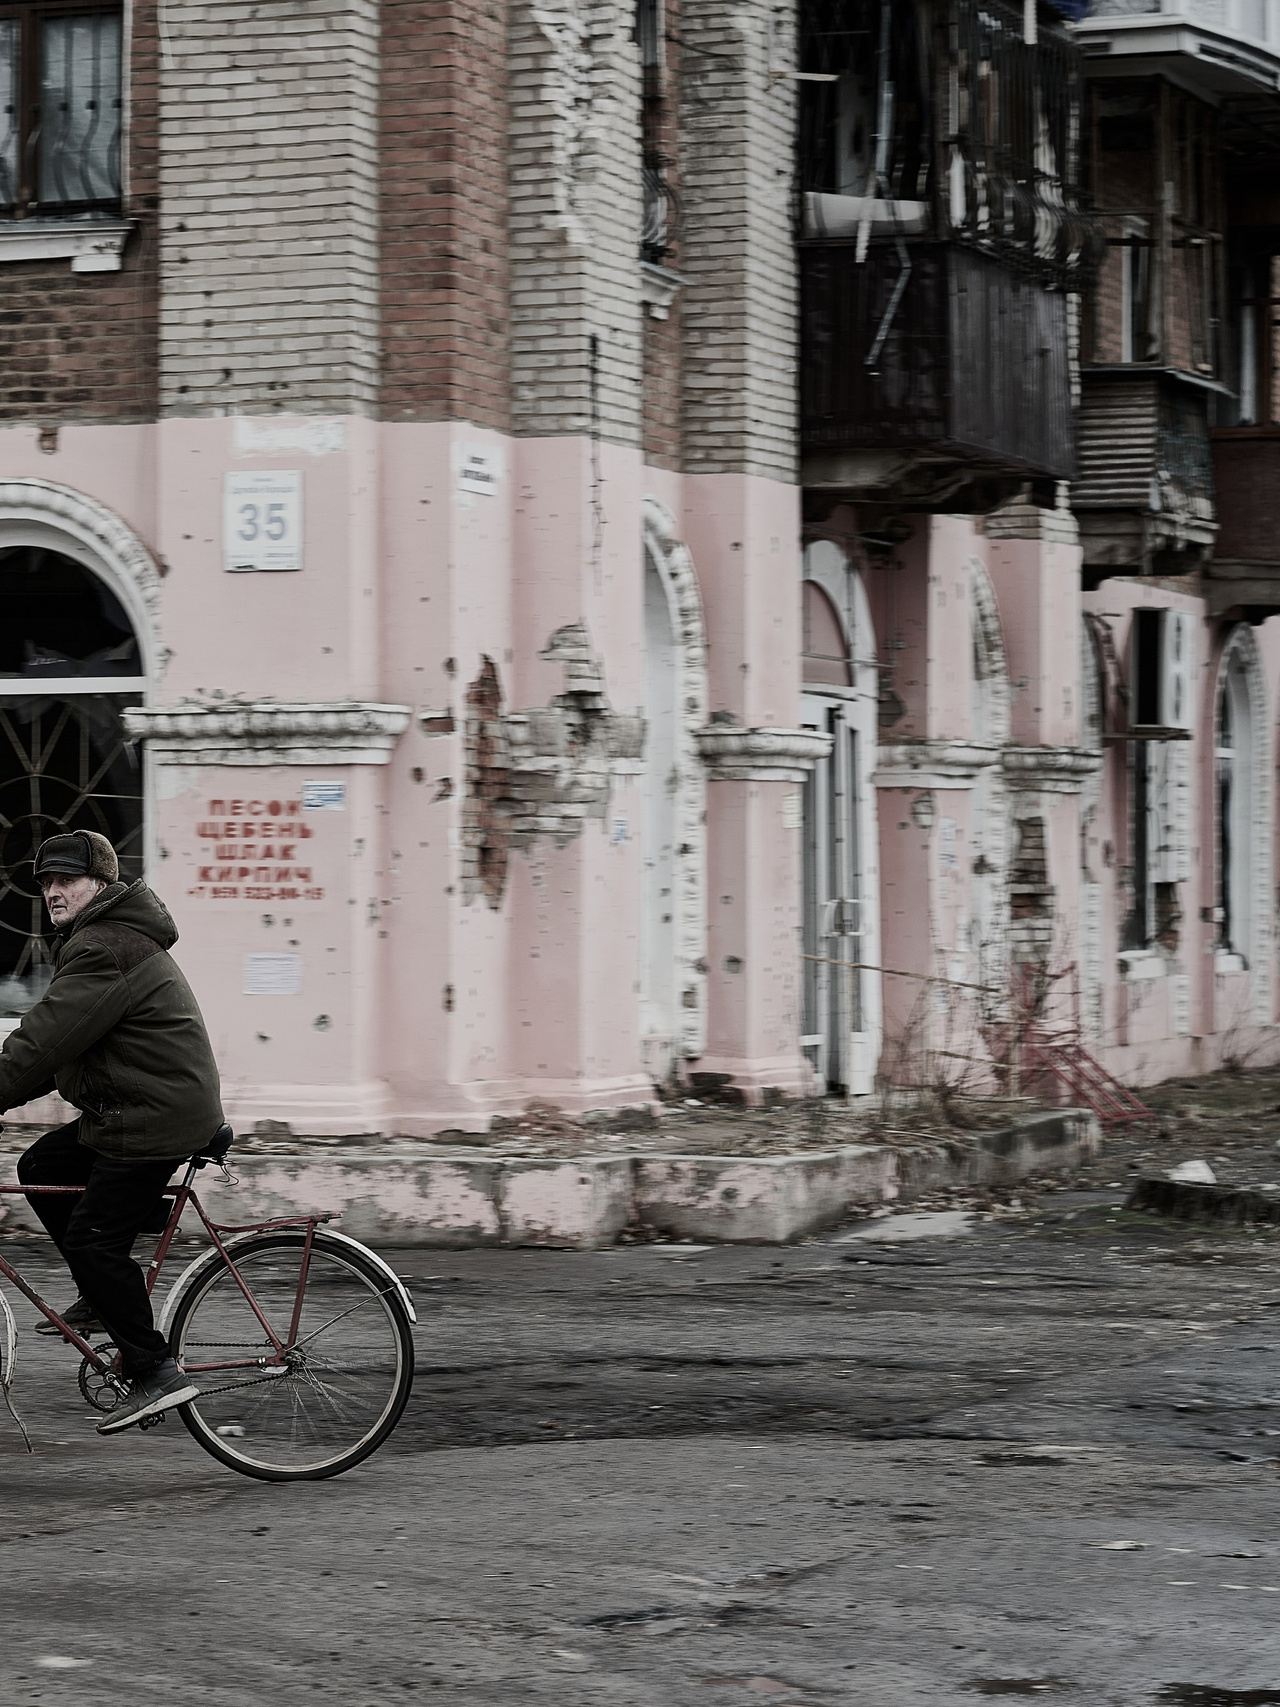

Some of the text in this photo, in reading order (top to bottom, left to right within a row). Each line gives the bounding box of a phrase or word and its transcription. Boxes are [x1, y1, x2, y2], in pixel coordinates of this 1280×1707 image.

[238, 503, 286, 541] 35
[210, 799, 302, 816] ПЕСОК
[197, 822, 314, 841] ЩЕБЕНЬ
[215, 844, 297, 860] ШЛАК
[197, 866, 312, 883] КИРПИЧ
